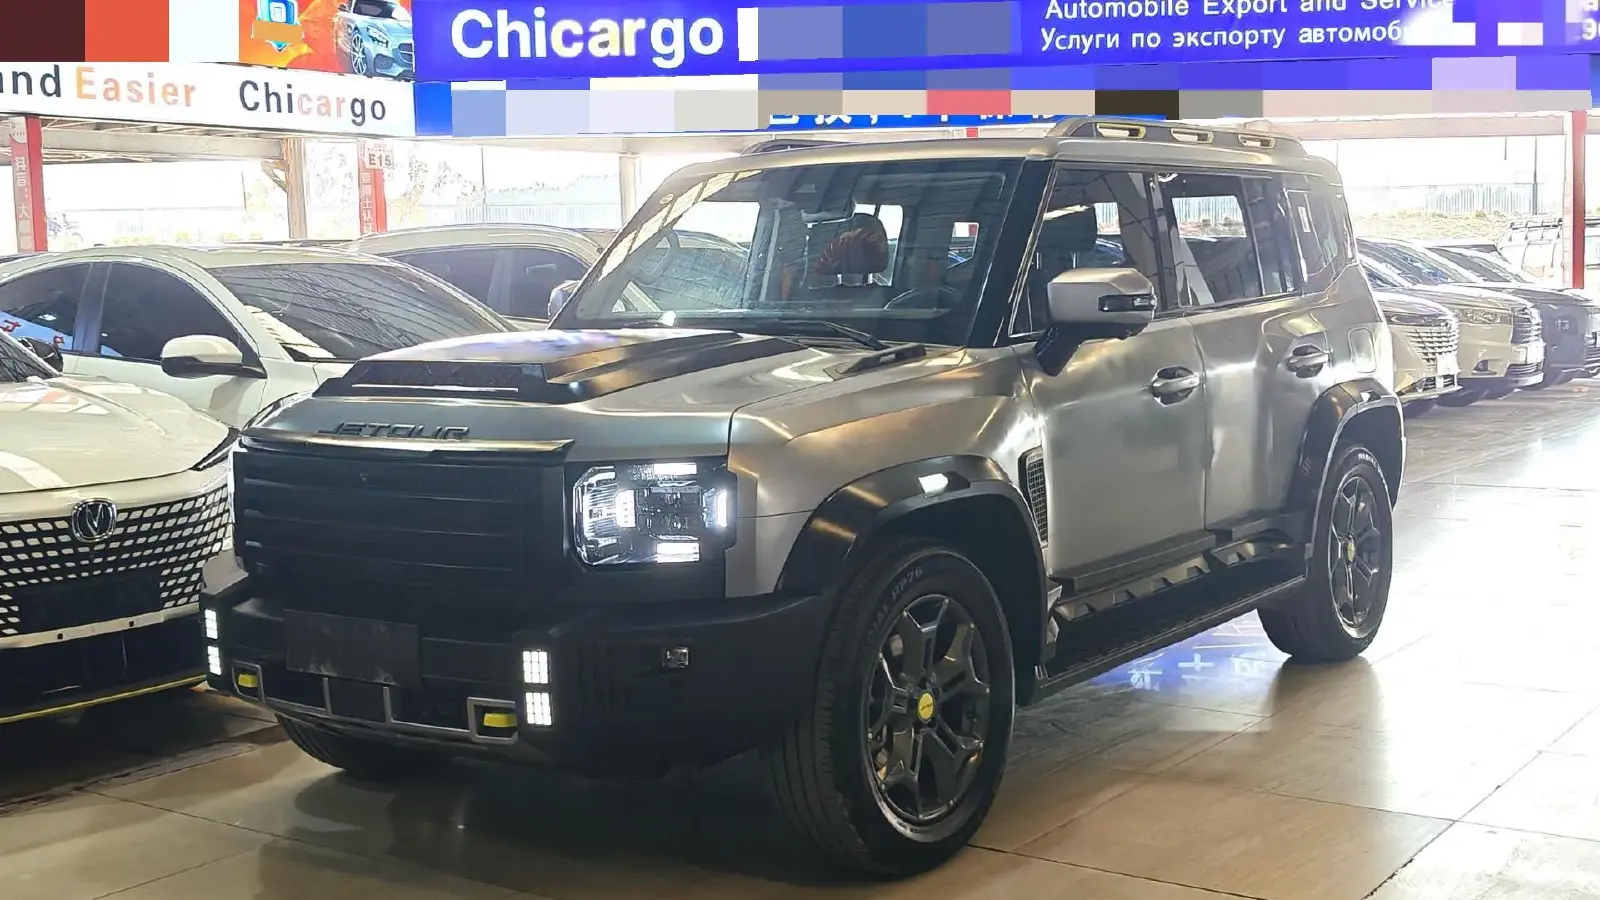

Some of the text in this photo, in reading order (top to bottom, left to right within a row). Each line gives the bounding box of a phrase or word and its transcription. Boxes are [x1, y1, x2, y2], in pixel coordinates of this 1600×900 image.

[1044, 0, 1453, 19] Automobile Export and Servic
[451, 7, 724, 69] Chicargo
[1041, 20, 1403, 54] Услуги по экспорту автомоб
[1582, 18, 1600, 40] 9
[0, 64, 196, 107] nd Easier
[239, 80, 386, 126] Chicargo
[368, 153, 391, 166] E15
[318, 421, 469, 440] JETOUR
